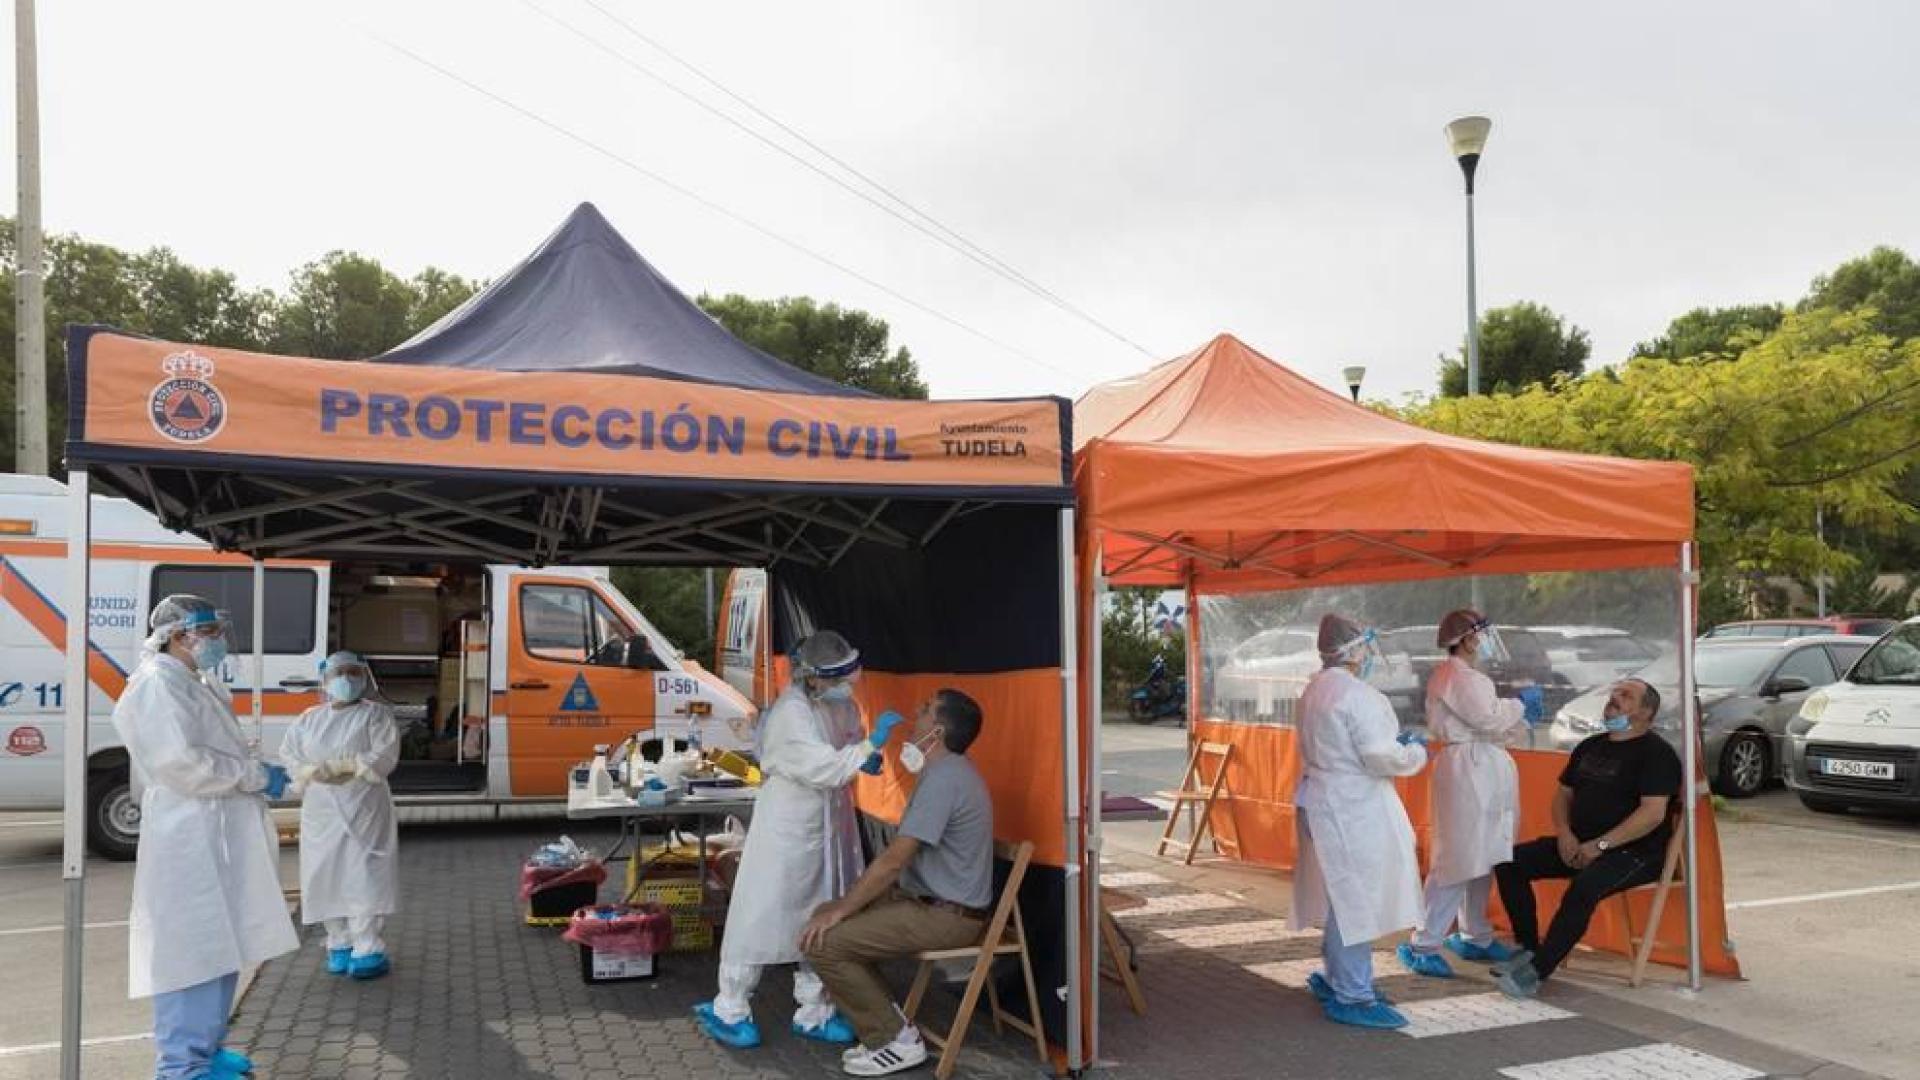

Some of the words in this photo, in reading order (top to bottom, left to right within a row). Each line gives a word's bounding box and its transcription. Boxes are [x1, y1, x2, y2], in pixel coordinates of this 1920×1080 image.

[319, 388, 745, 456] PROTECCIÓN
[767, 419, 912, 461] CIVIL
[940, 424, 1027, 435] Ayuntamiento
[941, 439, 1027, 457] TUDELA
[658, 678, 699, 695] D-561
